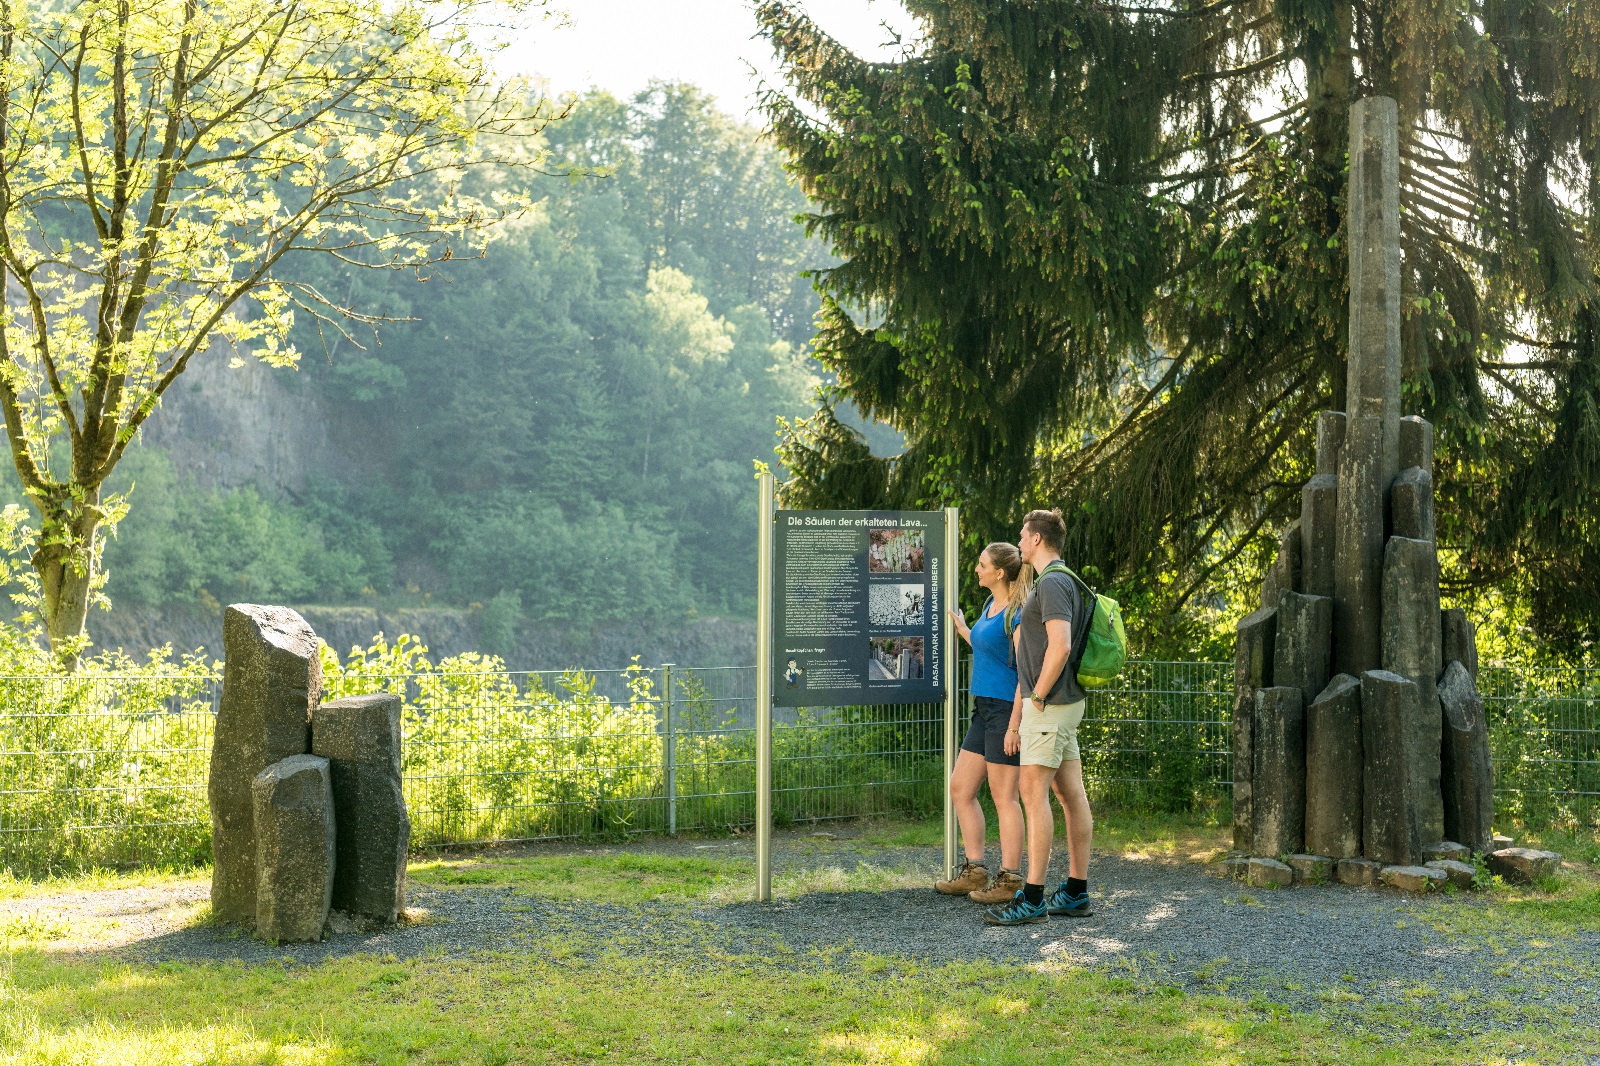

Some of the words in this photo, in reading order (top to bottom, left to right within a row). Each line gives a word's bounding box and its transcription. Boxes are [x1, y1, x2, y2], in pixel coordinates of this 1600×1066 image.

[788, 516, 802, 526] Die
[805, 516, 836, 526] Säulen
[838, 517, 853, 526] der
[855, 517, 898, 527] erkalteten
[931, 613, 939, 631] BAD
[931, 633, 939, 687] BASALTPARK
